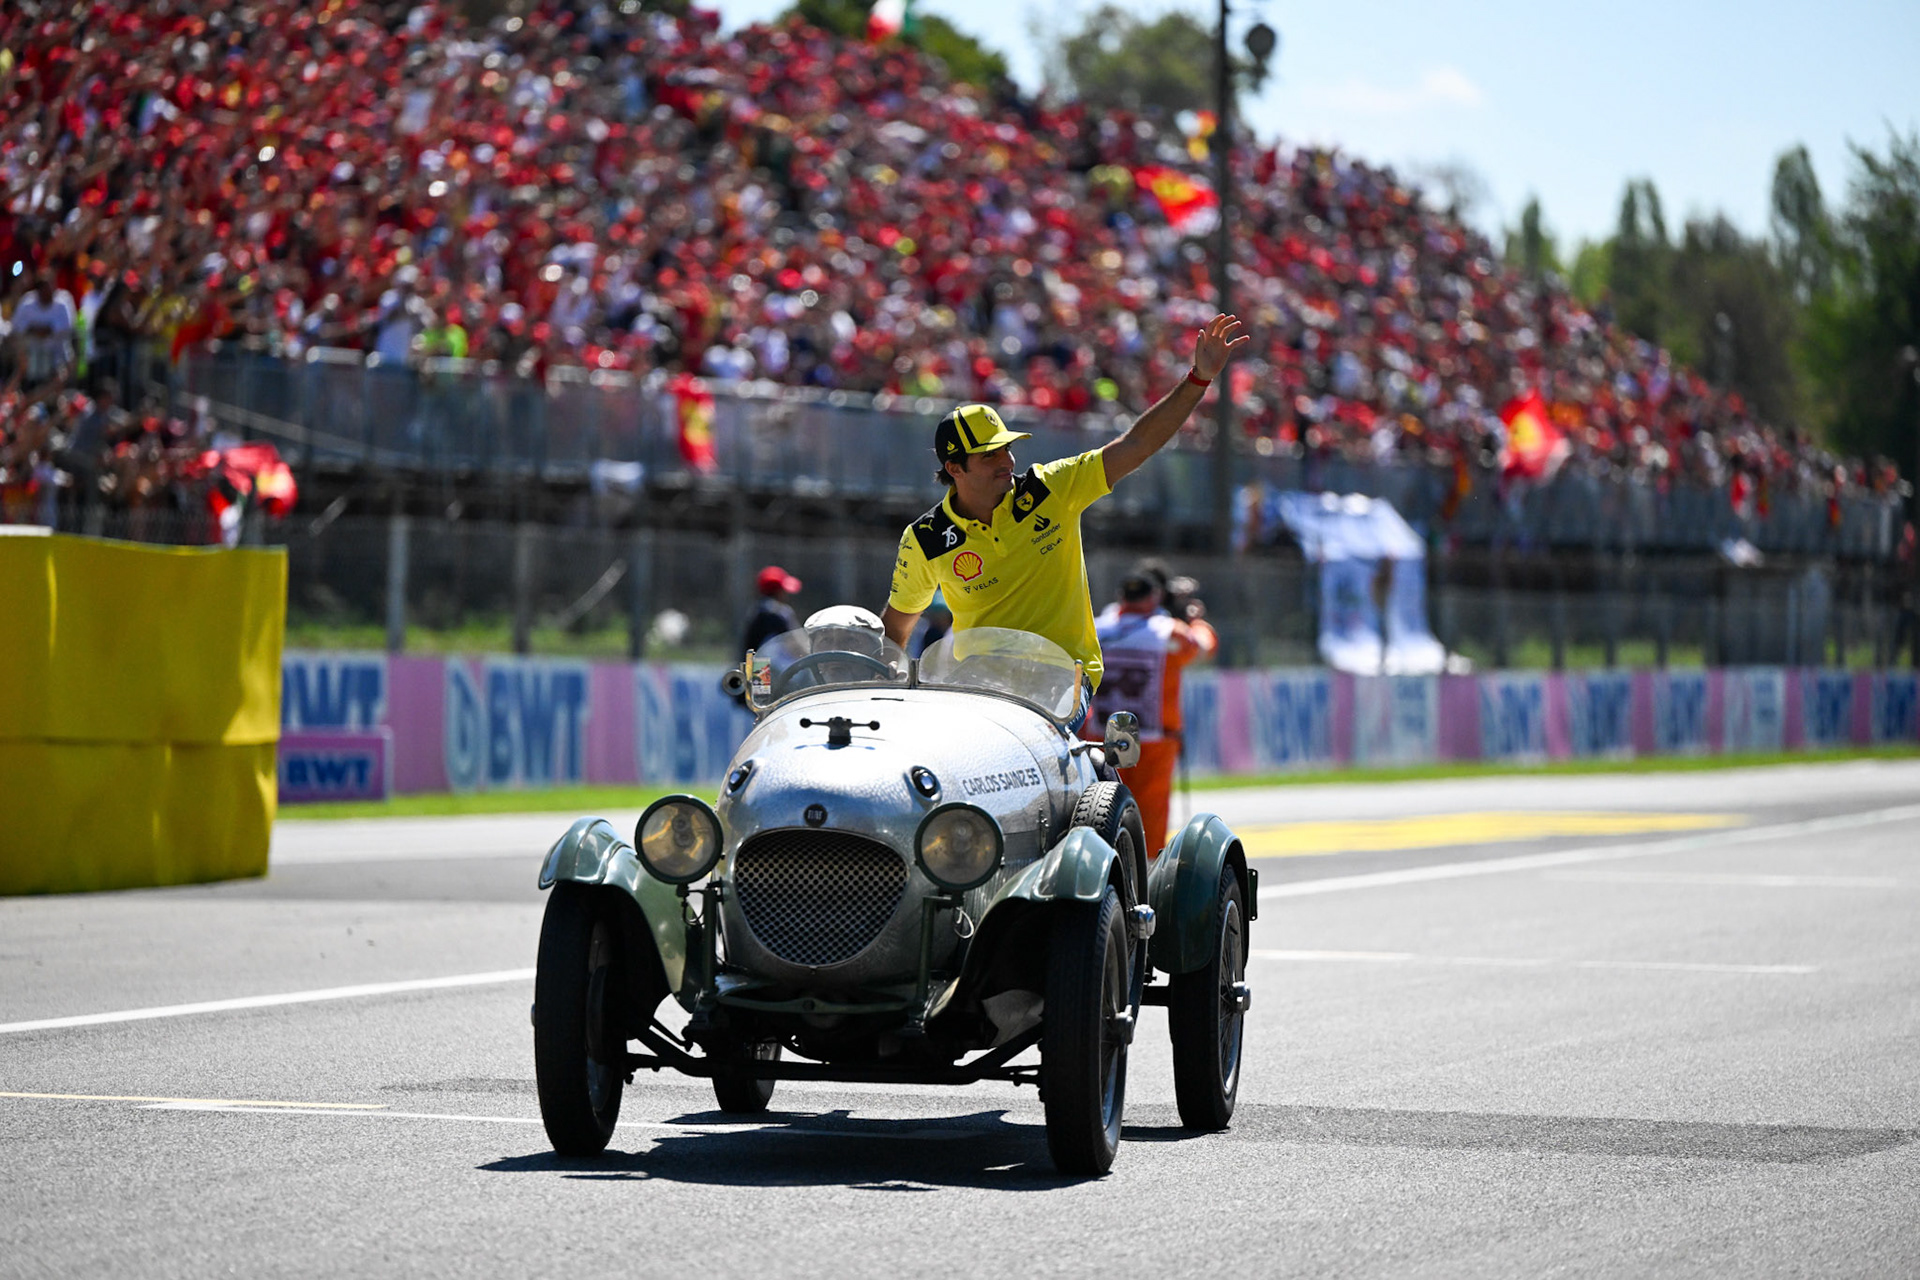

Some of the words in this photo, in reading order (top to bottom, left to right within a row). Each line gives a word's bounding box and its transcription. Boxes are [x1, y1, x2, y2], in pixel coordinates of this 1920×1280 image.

[1031, 523, 1061, 544] Santander
[973, 577, 999, 592] VELAS
[287, 756, 370, 786] BWT
[962, 774, 1001, 795] CARLOS
[999, 770, 1029, 790] SAINZ
[1027, 767, 1040, 785] 55
